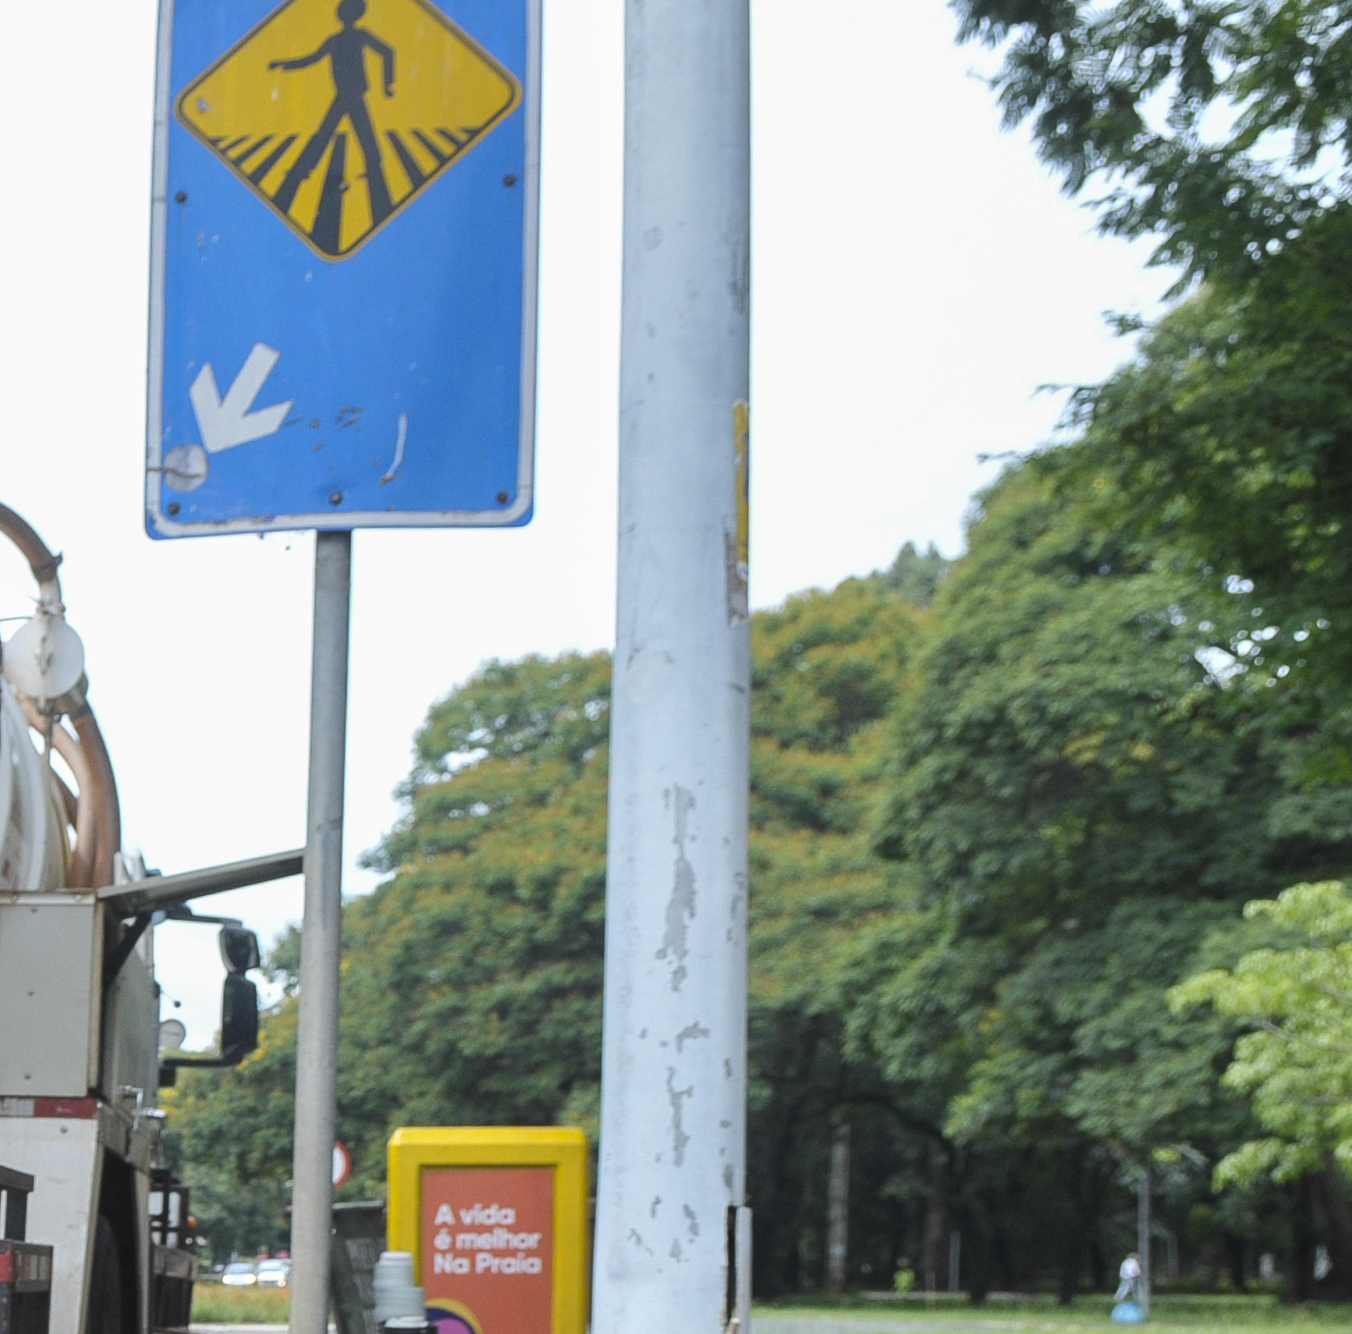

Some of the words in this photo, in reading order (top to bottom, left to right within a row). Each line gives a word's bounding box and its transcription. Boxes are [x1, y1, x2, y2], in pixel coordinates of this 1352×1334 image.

[434, 1203, 455, 1226] A
[459, 1203, 516, 1226] vida
[434, 1228, 453, 1251] é
[456, 1227, 542, 1250] melhor
[434, 1252, 471, 1275] Na
[476, 1251, 542, 1275] Praia
